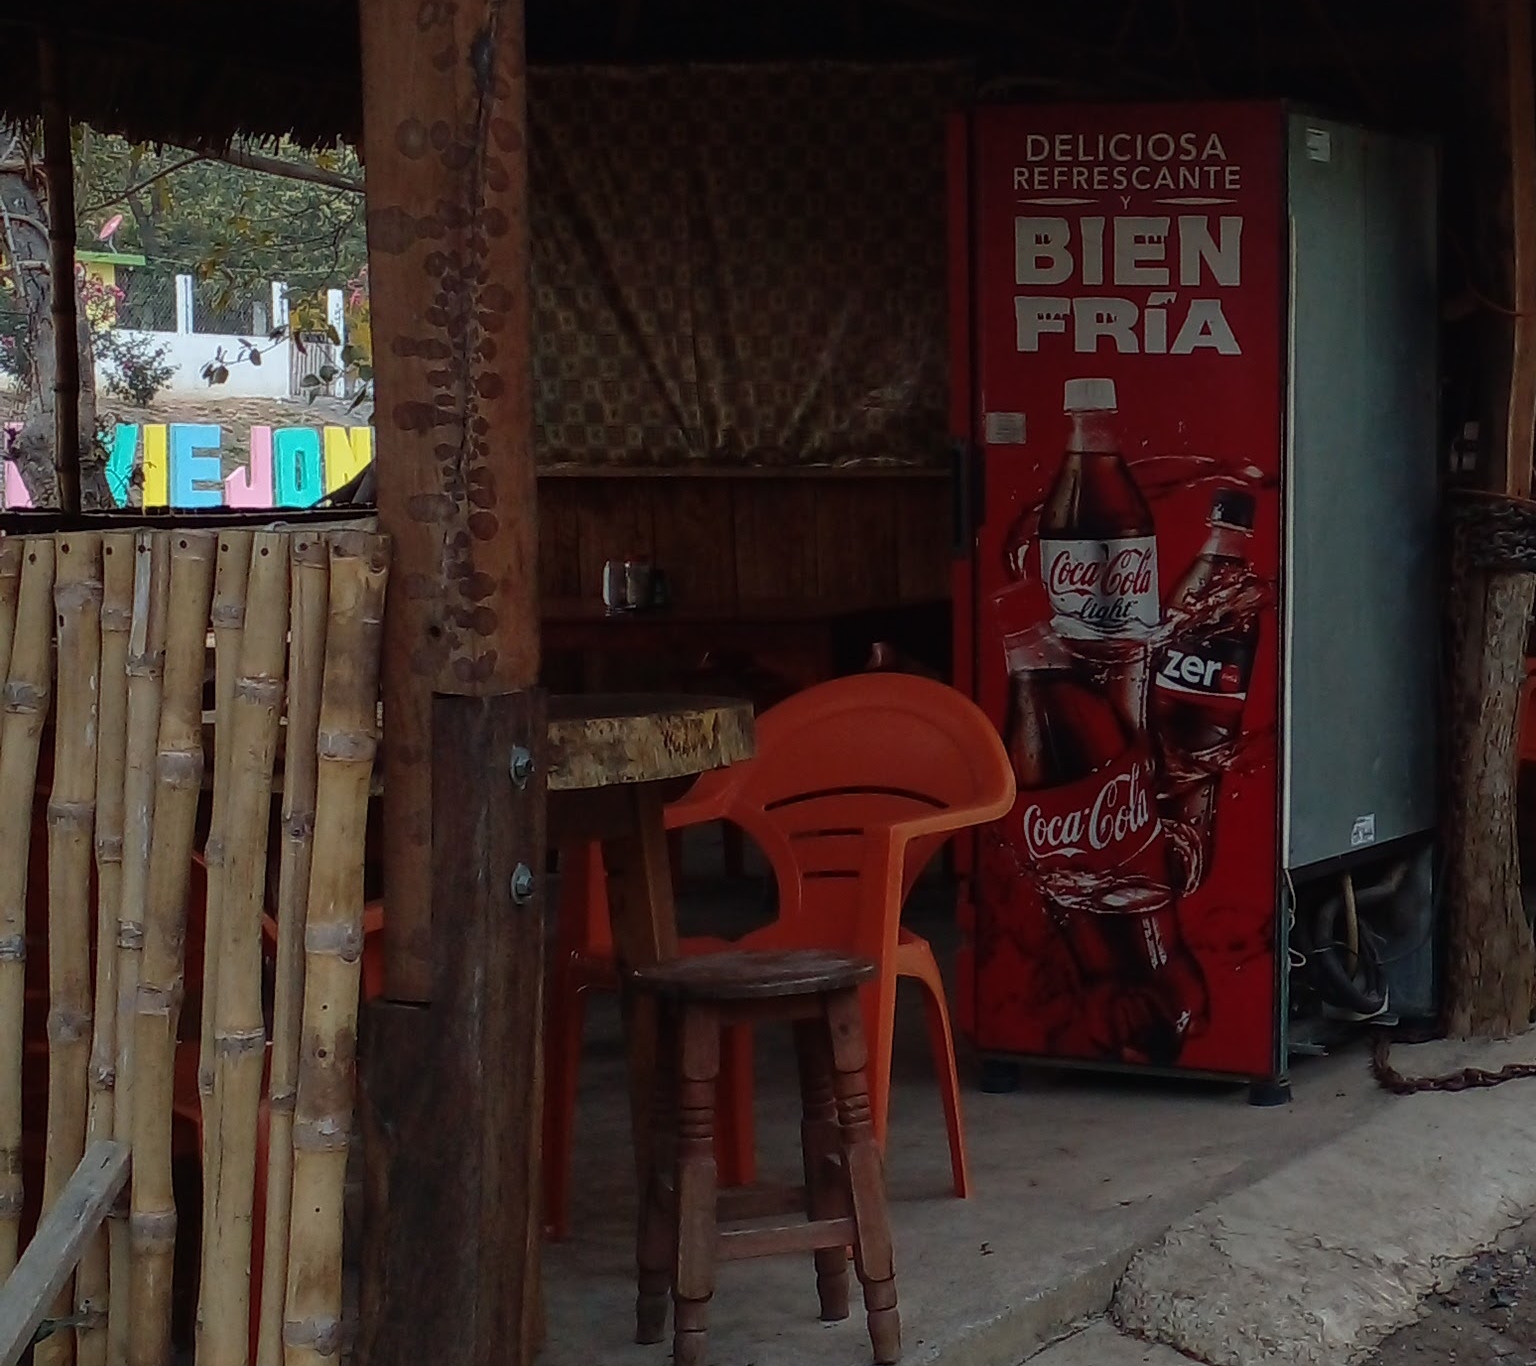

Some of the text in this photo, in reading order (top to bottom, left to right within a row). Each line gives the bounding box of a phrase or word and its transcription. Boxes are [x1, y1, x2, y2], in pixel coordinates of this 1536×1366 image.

[1026, 133, 1227, 162] DELICIOSA
[1013, 166, 1242, 191] REFRESCANTE
[1119, 195, 1132, 210] Y
[1014, 215, 1244, 287] BIEN
[1013, 291, 1243, 355] FRÍA
[1080, 597, 1139, 621] light
[1023, 762, 1154, 859] Coca-Cola
